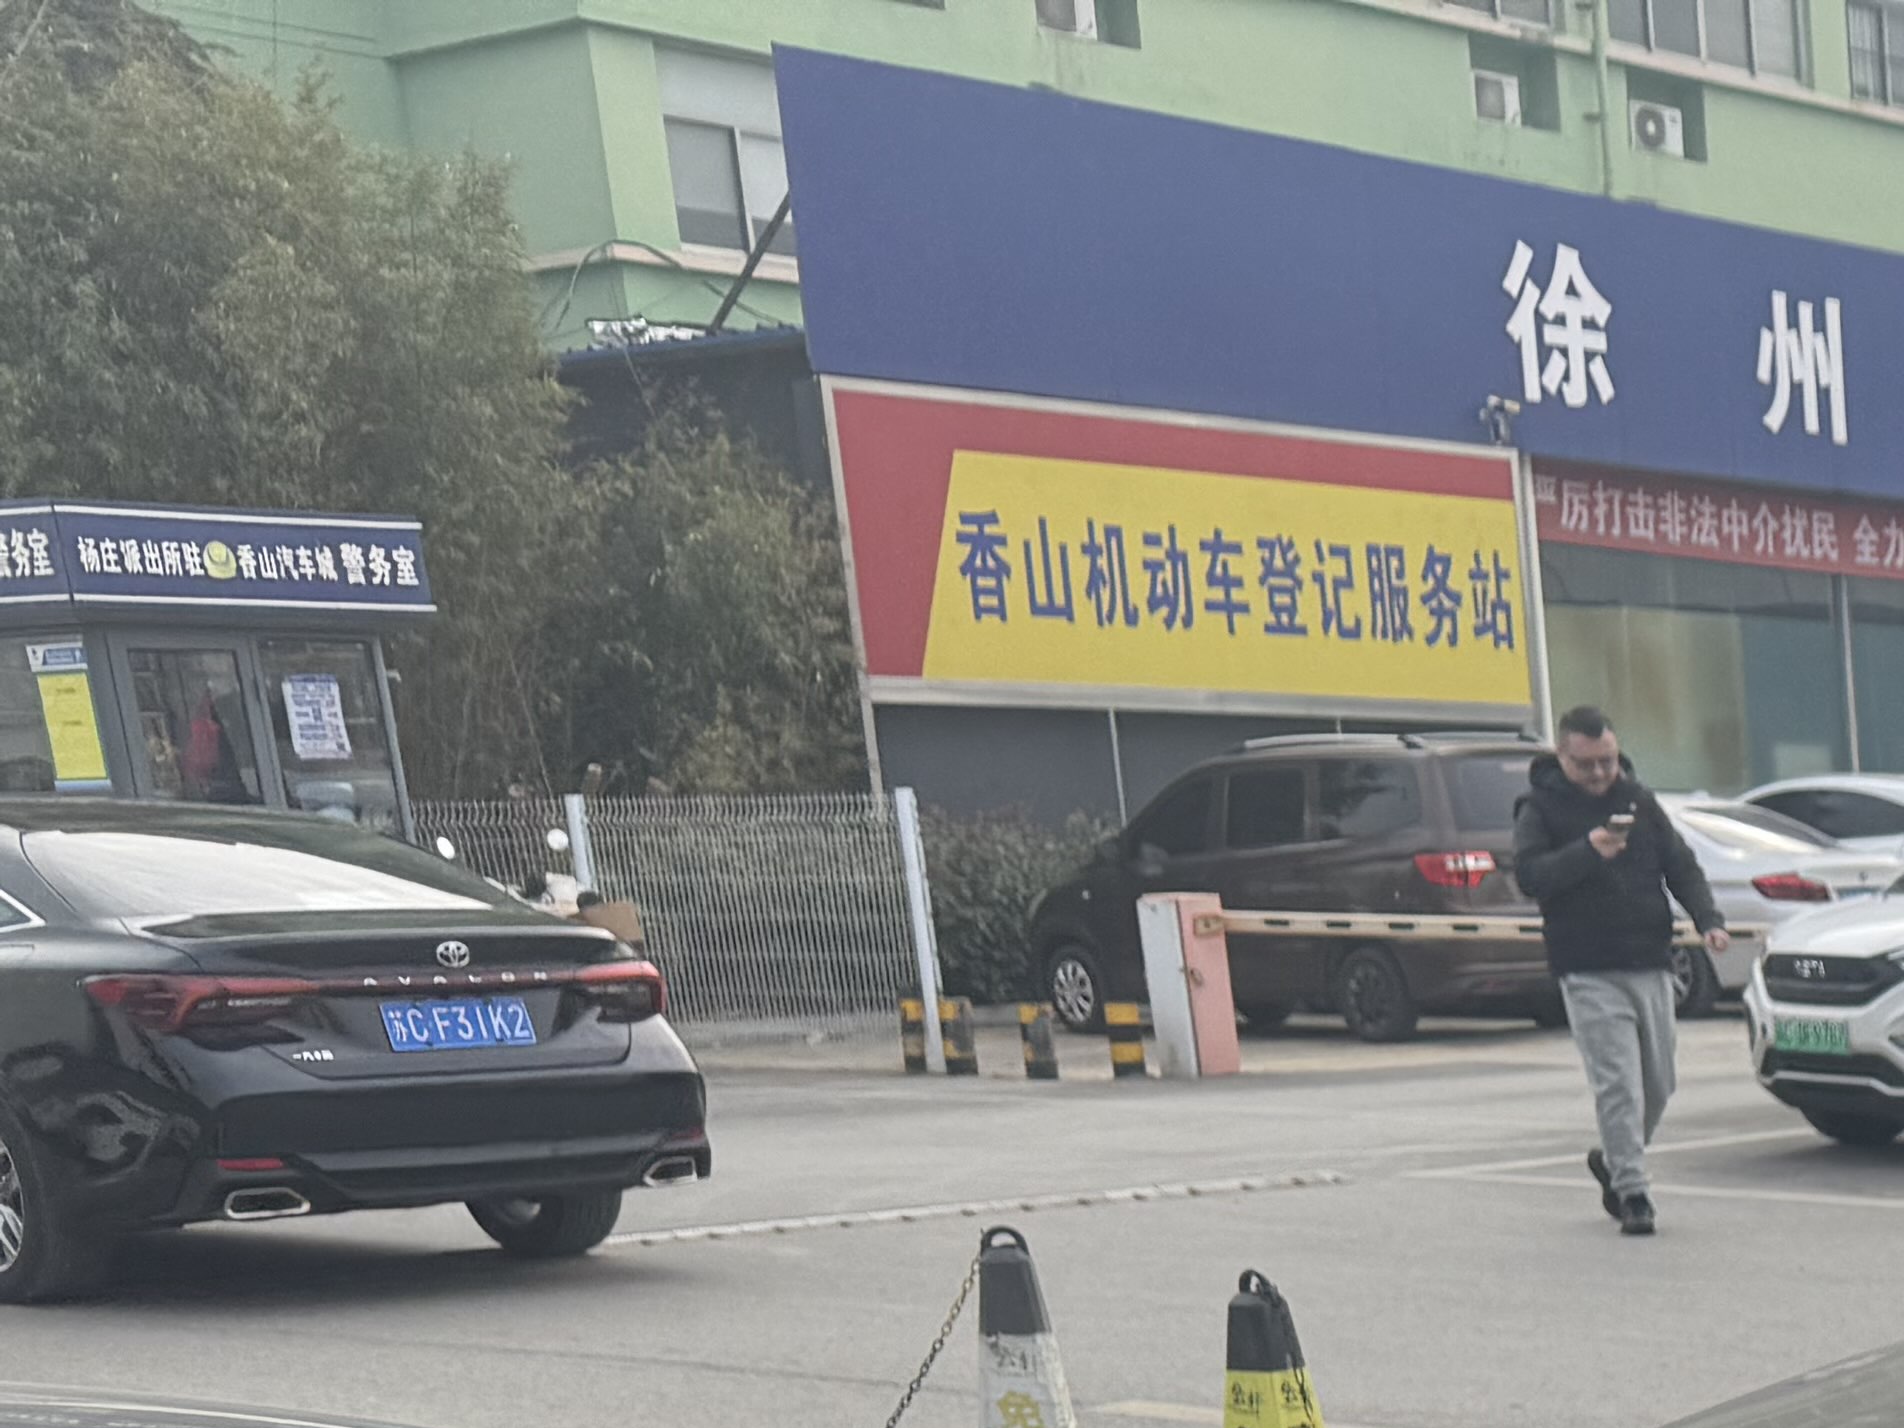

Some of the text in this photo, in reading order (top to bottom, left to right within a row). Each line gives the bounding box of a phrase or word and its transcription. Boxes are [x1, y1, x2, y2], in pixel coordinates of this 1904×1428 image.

[77, 535, 420, 586] 杨庄派出所驻 香山汽车城 警务室
[955, 510, 1515, 651] 香山机动车登记服务站
